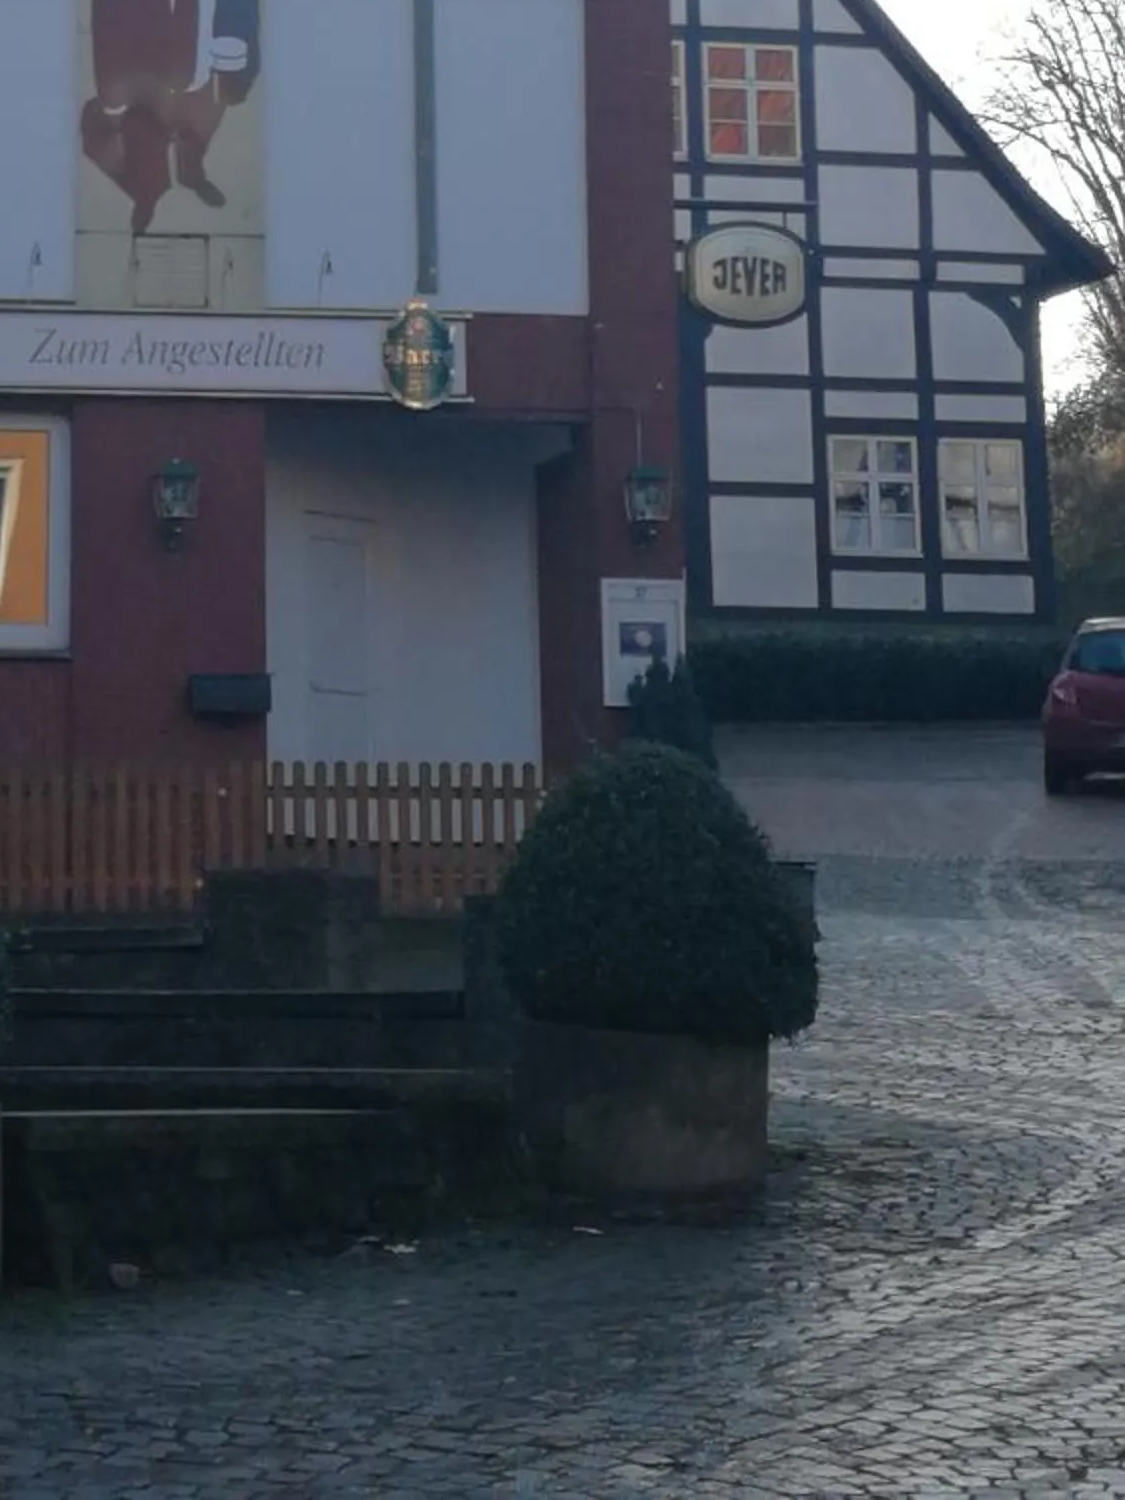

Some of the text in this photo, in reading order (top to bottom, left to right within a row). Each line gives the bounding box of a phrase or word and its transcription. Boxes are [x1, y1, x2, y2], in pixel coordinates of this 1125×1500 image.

[712, 256, 787, 297] JEVER
[28, 328, 110, 366] Zum
[121, 330, 325, 374] Angestellten
